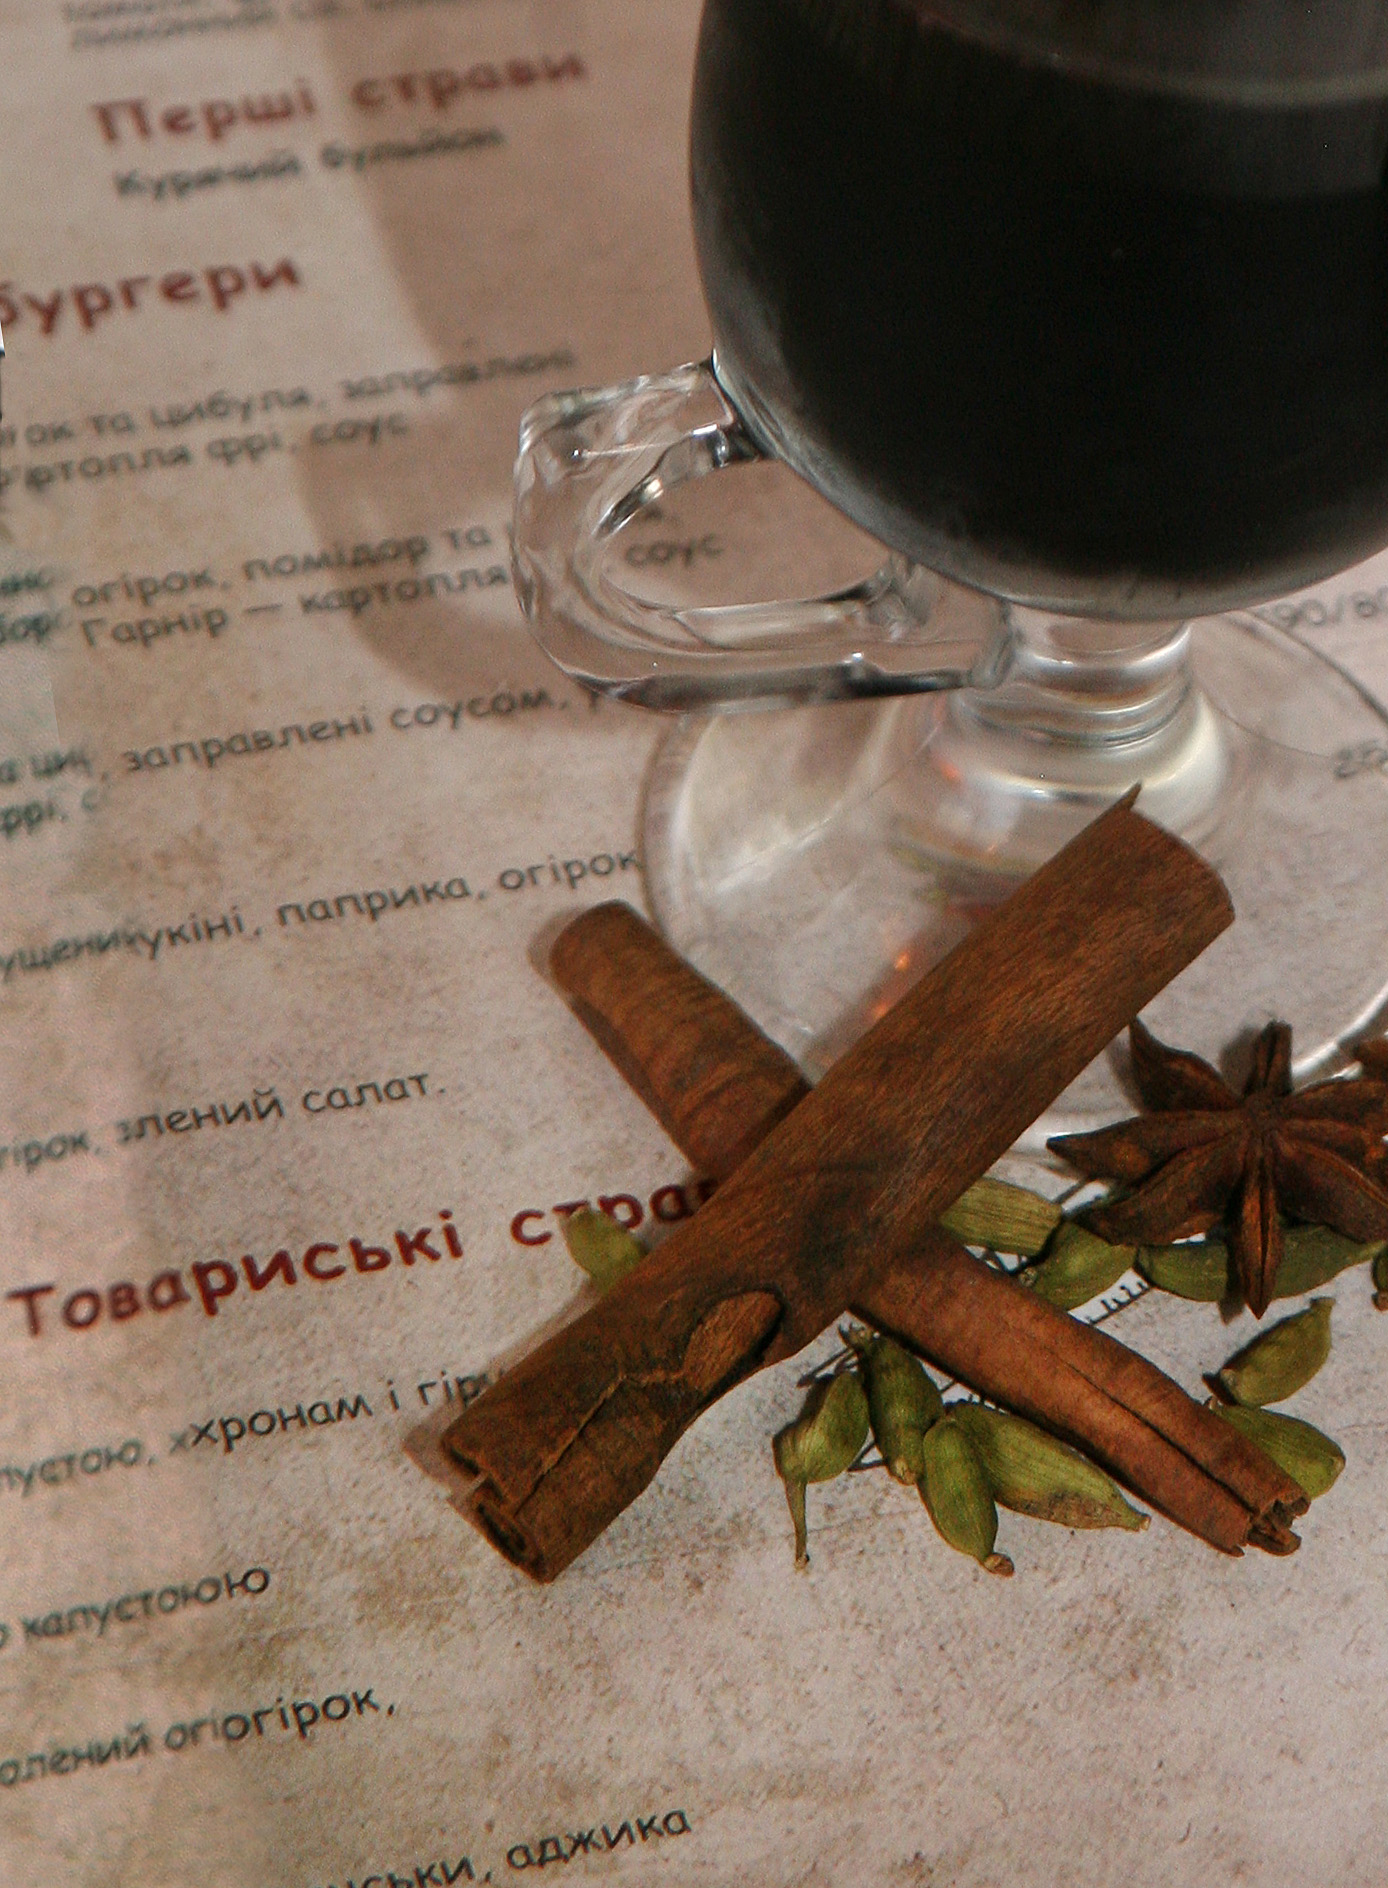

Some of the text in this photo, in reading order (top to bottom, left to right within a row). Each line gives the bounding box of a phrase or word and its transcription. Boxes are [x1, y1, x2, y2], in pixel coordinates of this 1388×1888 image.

[95, 52, 588, 145] Перші страви
[79, 606, 228, 652] Гарнір
[276, 875, 487, 930] паприка,
[499, 848, 644, 898] огірок
[302, 1071, 447, 1117] салат.
[3, 1210, 464, 1338] Товариські
[417, 1368, 506, 1410] гір
[506, 1809, 692, 1870] аджика
